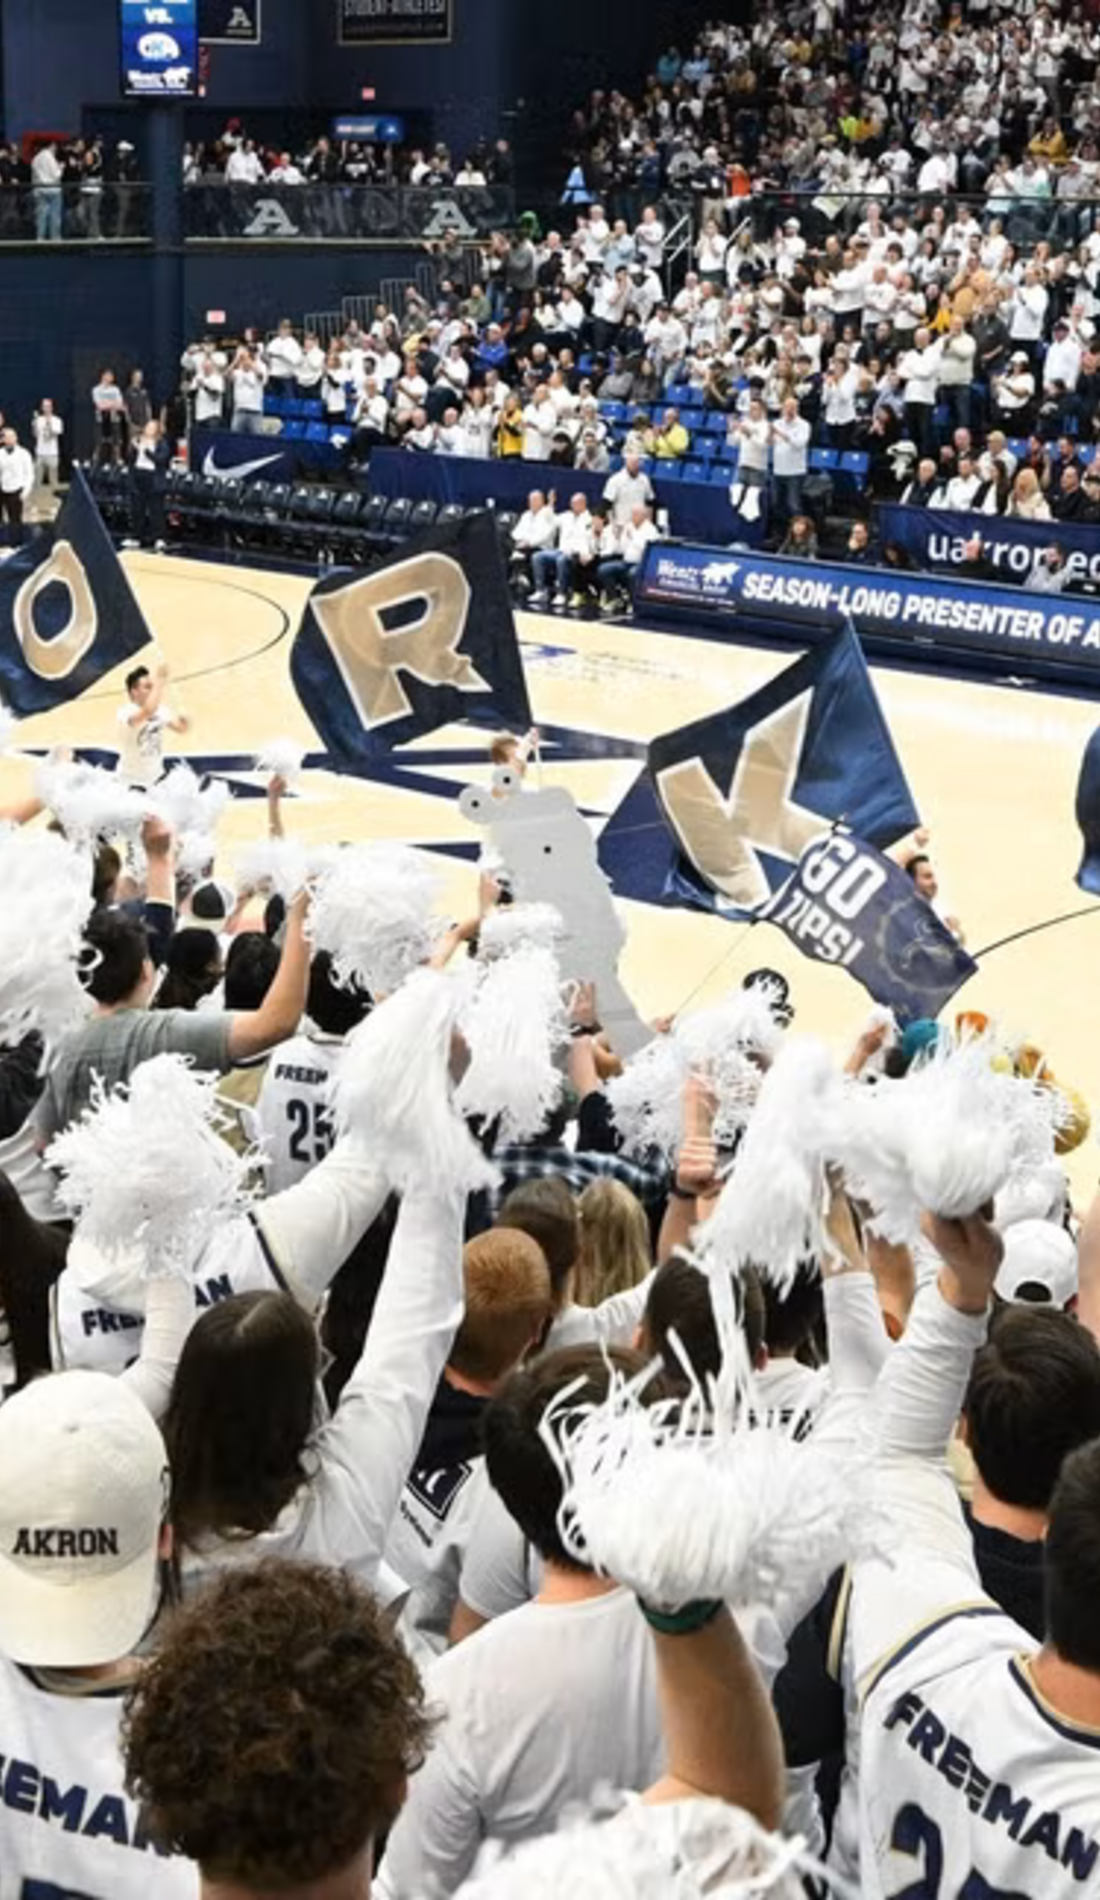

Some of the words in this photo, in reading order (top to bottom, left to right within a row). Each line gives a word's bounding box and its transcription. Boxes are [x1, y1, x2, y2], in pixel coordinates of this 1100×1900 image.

[243, 199, 299, 235] A
[423, 201, 478, 235] A
[14, 540, 98, 682] O
[310, 551, 493, 732] R
[742, 571, 901, 619] SEASON-LONG
[902, 594, 1044, 641] PRESENTER
[1047, 614, 1083, 644] OF
[656, 686, 838, 911] K
[802, 836, 887, 919] GO
[12, 1527, 119, 1557] AKRON
[0, 1754, 172, 1859] EMA
[883, 1691, 1100, 1882] FREEMAN
